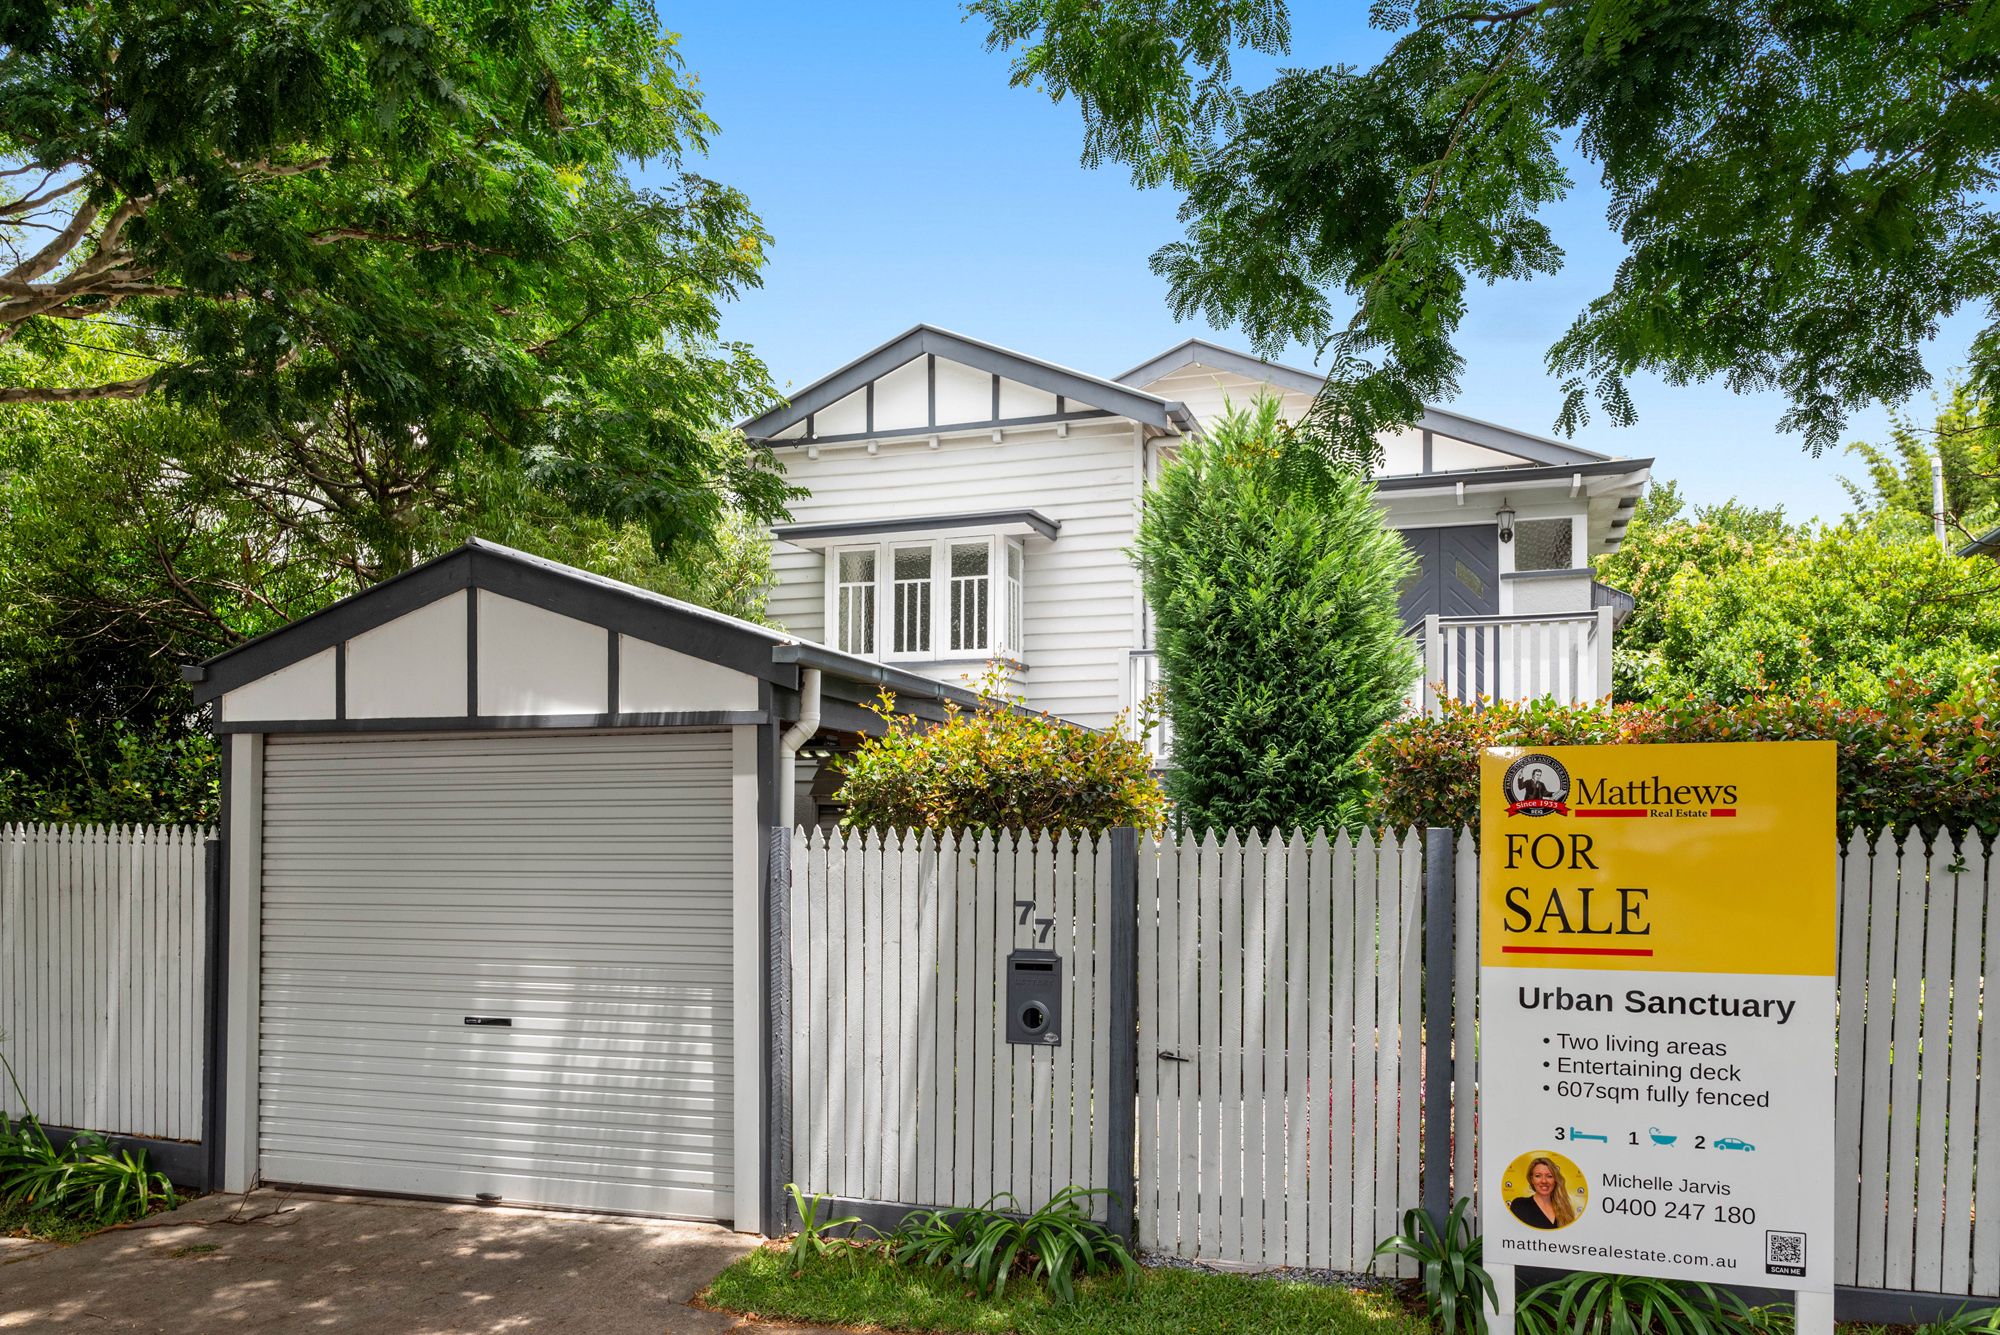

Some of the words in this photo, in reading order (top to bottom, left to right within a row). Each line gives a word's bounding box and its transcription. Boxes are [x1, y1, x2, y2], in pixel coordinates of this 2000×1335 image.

[1576, 776, 1737, 805] Matthews
[1650, 809, 1673, 818] Real
[1676, 808, 1708, 818] Estate
[1504, 834, 1599, 869] FOR
[1504, 887, 1651, 935] SALE
[1519, 986, 1613, 1012] Urban
[1625, 990, 1796, 1025] Sanctuary
[1557, 1033, 1599, 1051] Two
[1606, 1035, 1659, 1058] living
[1667, 1041, 1727, 1056] areas
[1558, 1057, 1682, 1083] Entertaining
[1690, 1063, 1741, 1081] deck
[1557, 1081, 1639, 1104] 607sqm
[1646, 1085, 1689, 1107] fully
[1696, 1088, 1769, 1108] fenced
[1555, 1127, 1565, 1141] 3
[1629, 1131, 1639, 1145] 1
[1695, 1135, 1706, 1149] 2
[1602, 1173, 1673, 1192] Michelle
[1679, 1178, 1731, 1196] Jarvis
[1602, 1197, 1657, 1217] 0400
[1664, 1201, 1706, 1220] 247
[1714, 1206, 1756, 1225] 180
[1502, 1238, 1737, 1269] matthewsrealestate.com.au
[1771, 1266, 1790, 1274] SCAN
